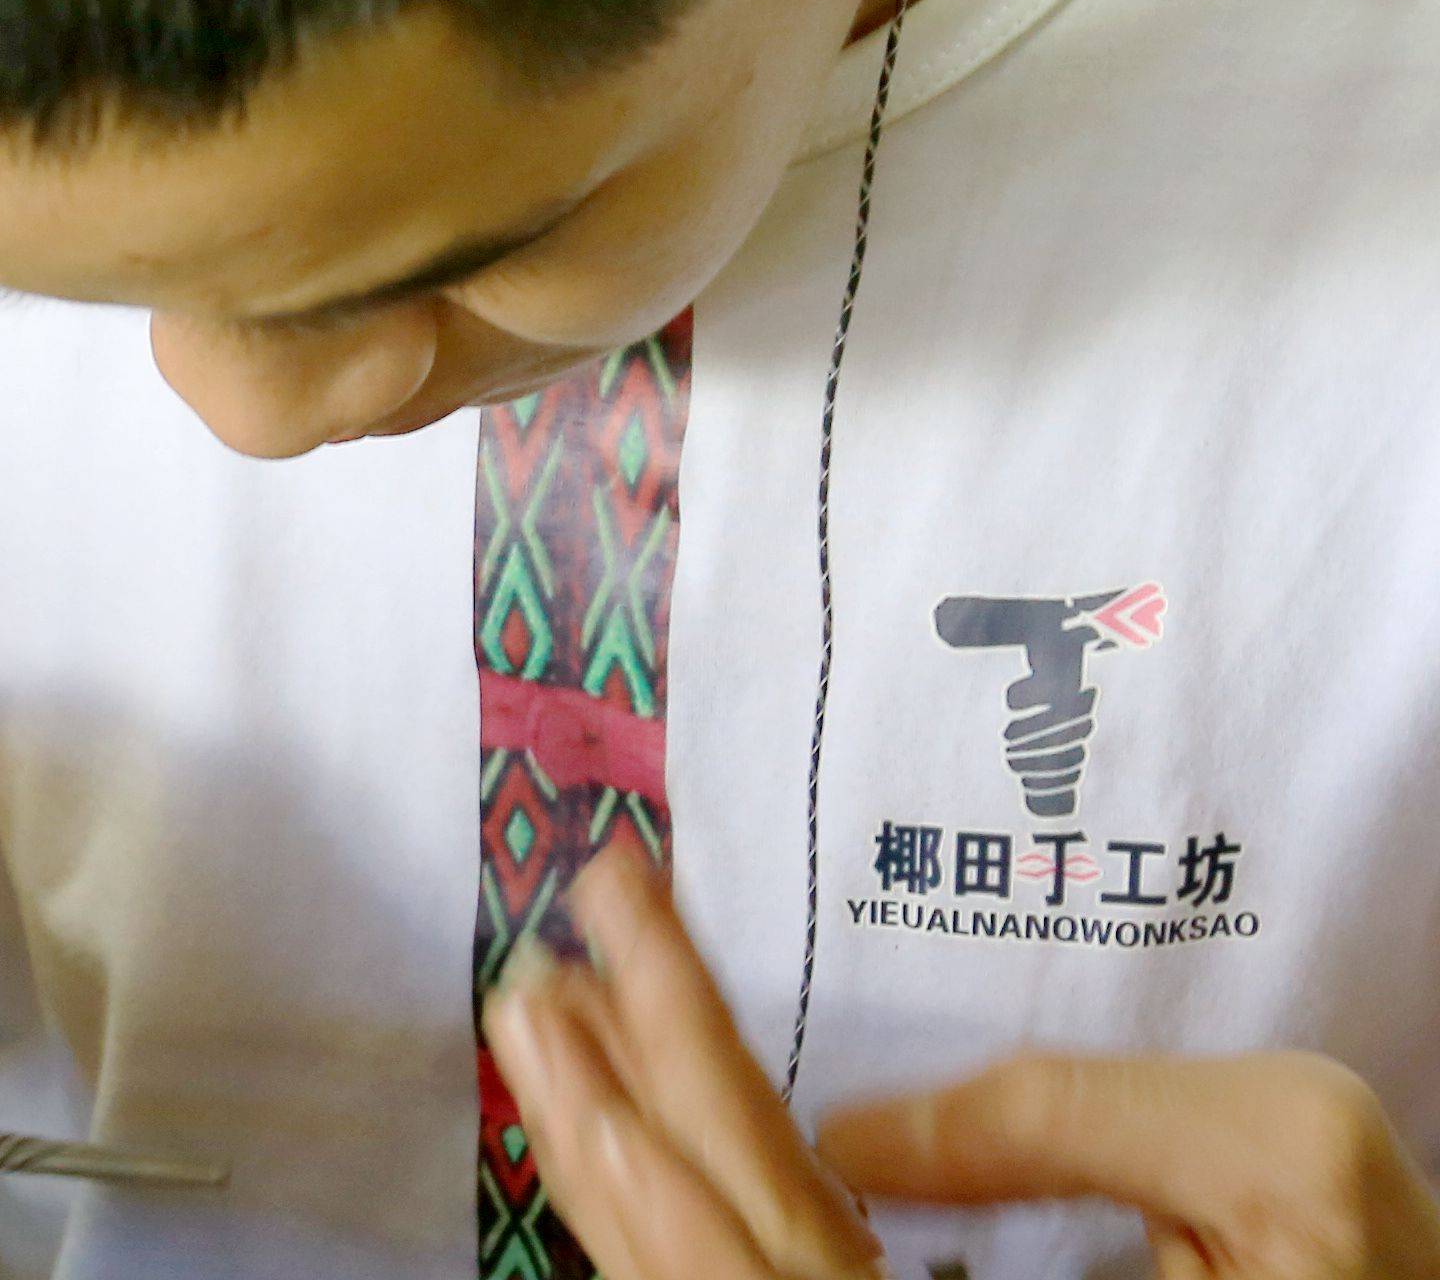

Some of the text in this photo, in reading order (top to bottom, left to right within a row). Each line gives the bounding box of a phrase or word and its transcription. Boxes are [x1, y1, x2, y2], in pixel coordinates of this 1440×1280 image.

[873, 820, 1242, 909] 椰田手工坊
[846, 898, 1260, 949] YIEUALNANQWONKSAO
